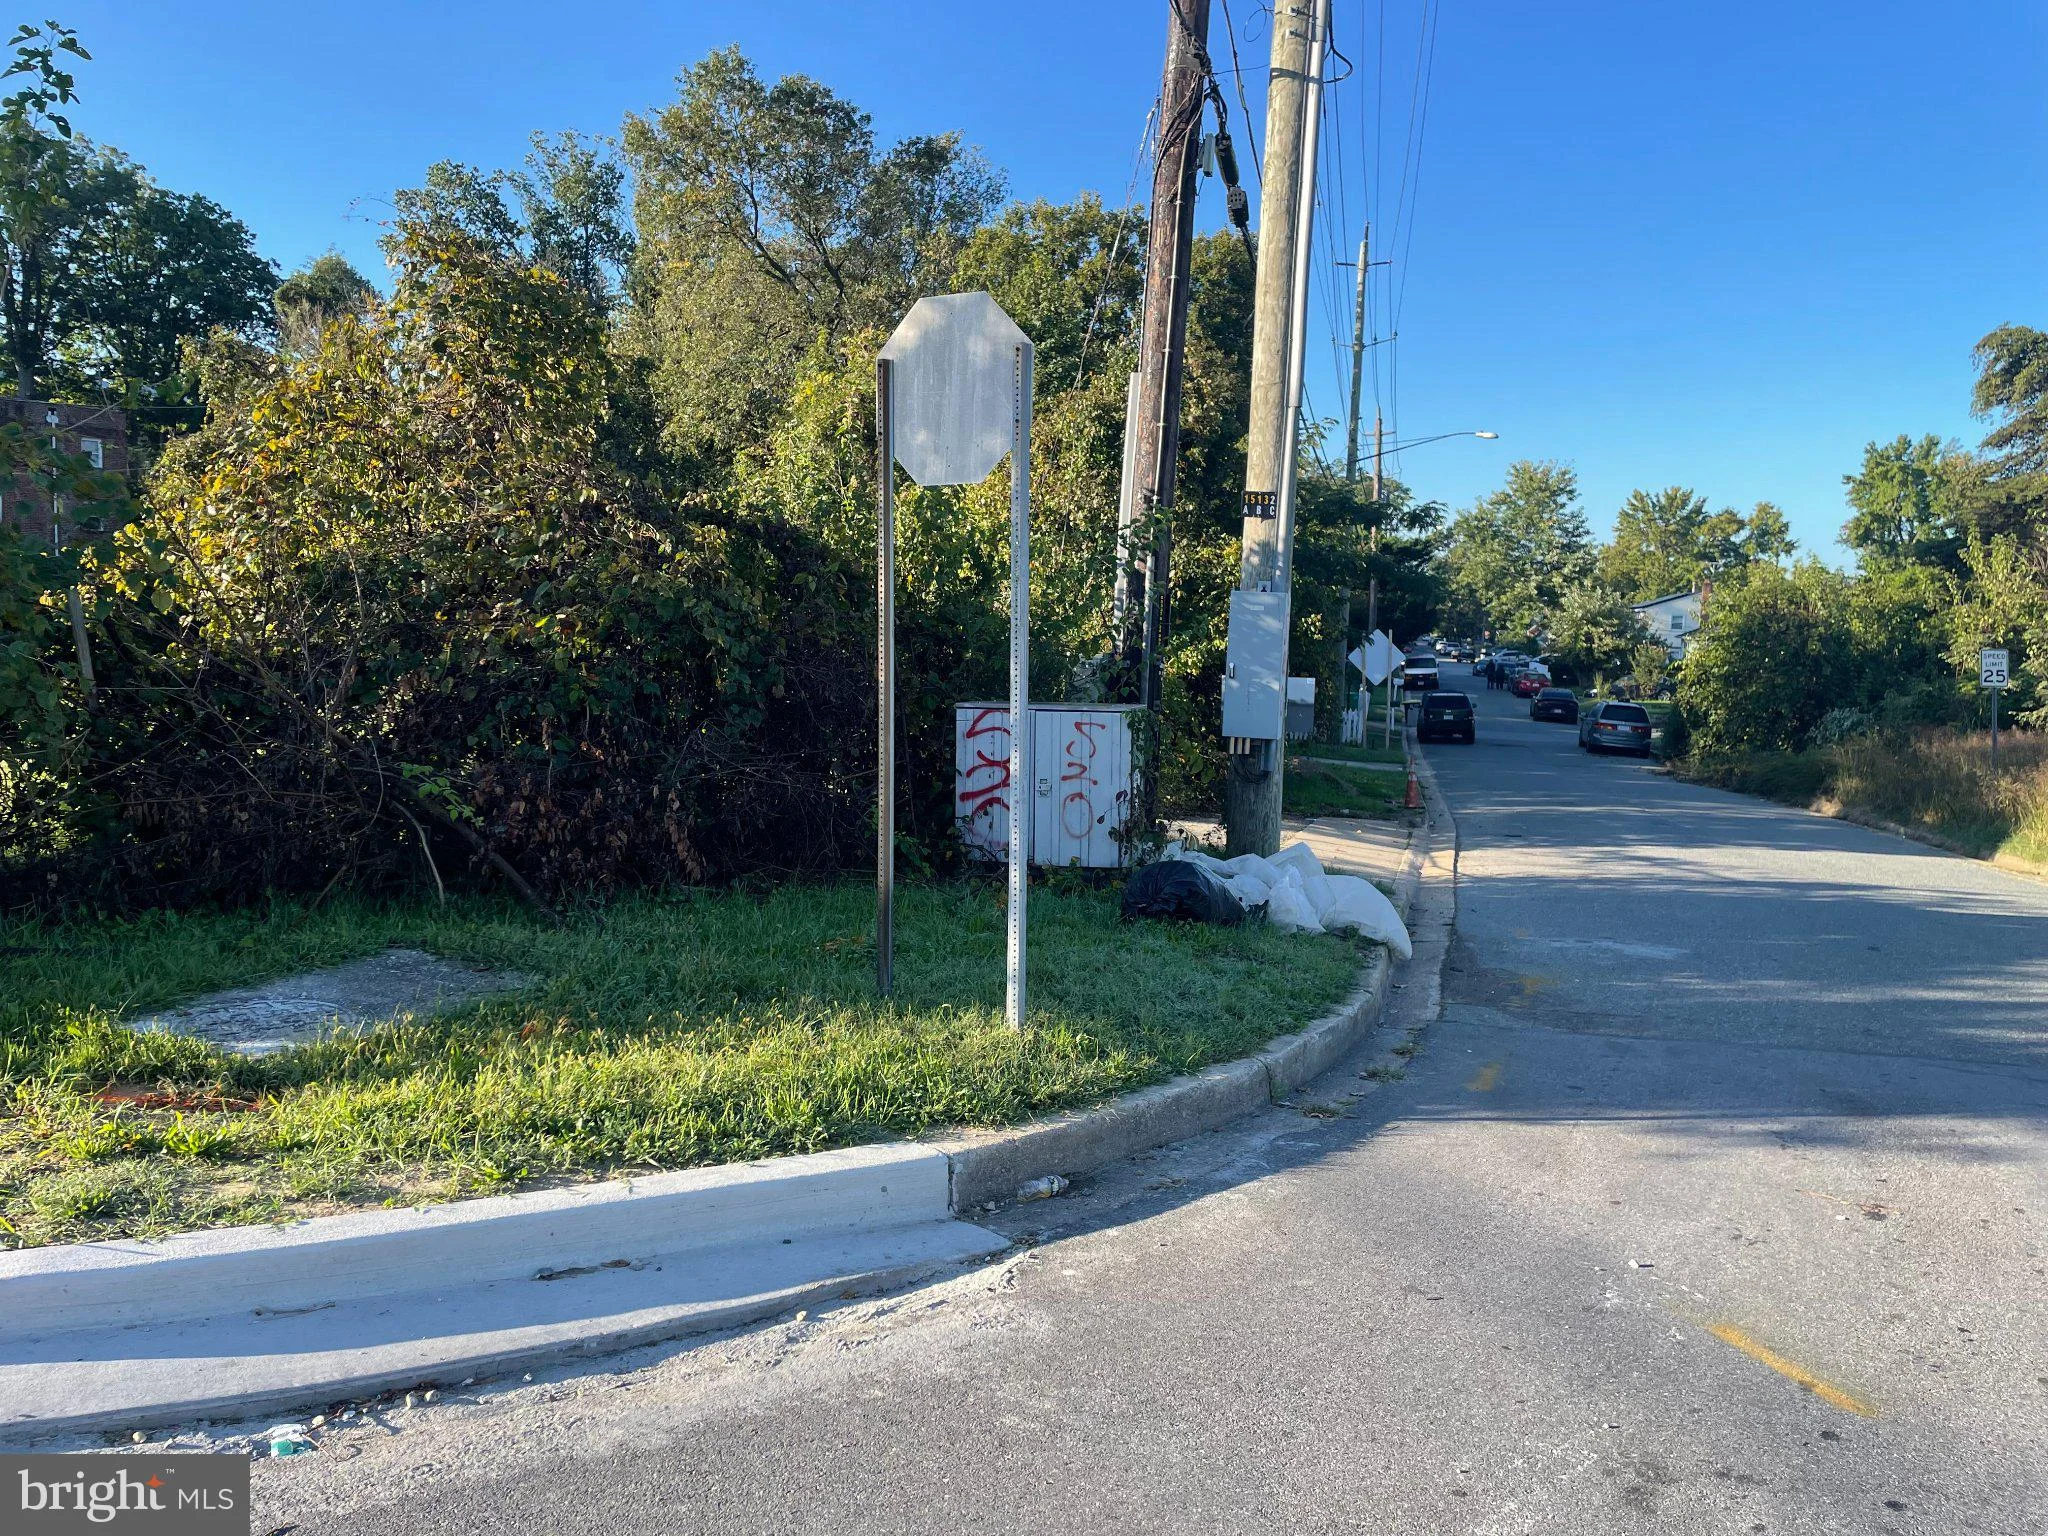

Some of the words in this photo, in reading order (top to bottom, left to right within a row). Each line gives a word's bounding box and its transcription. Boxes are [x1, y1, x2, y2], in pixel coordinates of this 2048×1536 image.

[1244, 494, 1276, 505] 15132
[1242, 505, 1248, 514] A
[1256, 505, 1262, 515] B
[1269, 505, 1275, 516] C
[1983, 669, 2006, 683] 25
